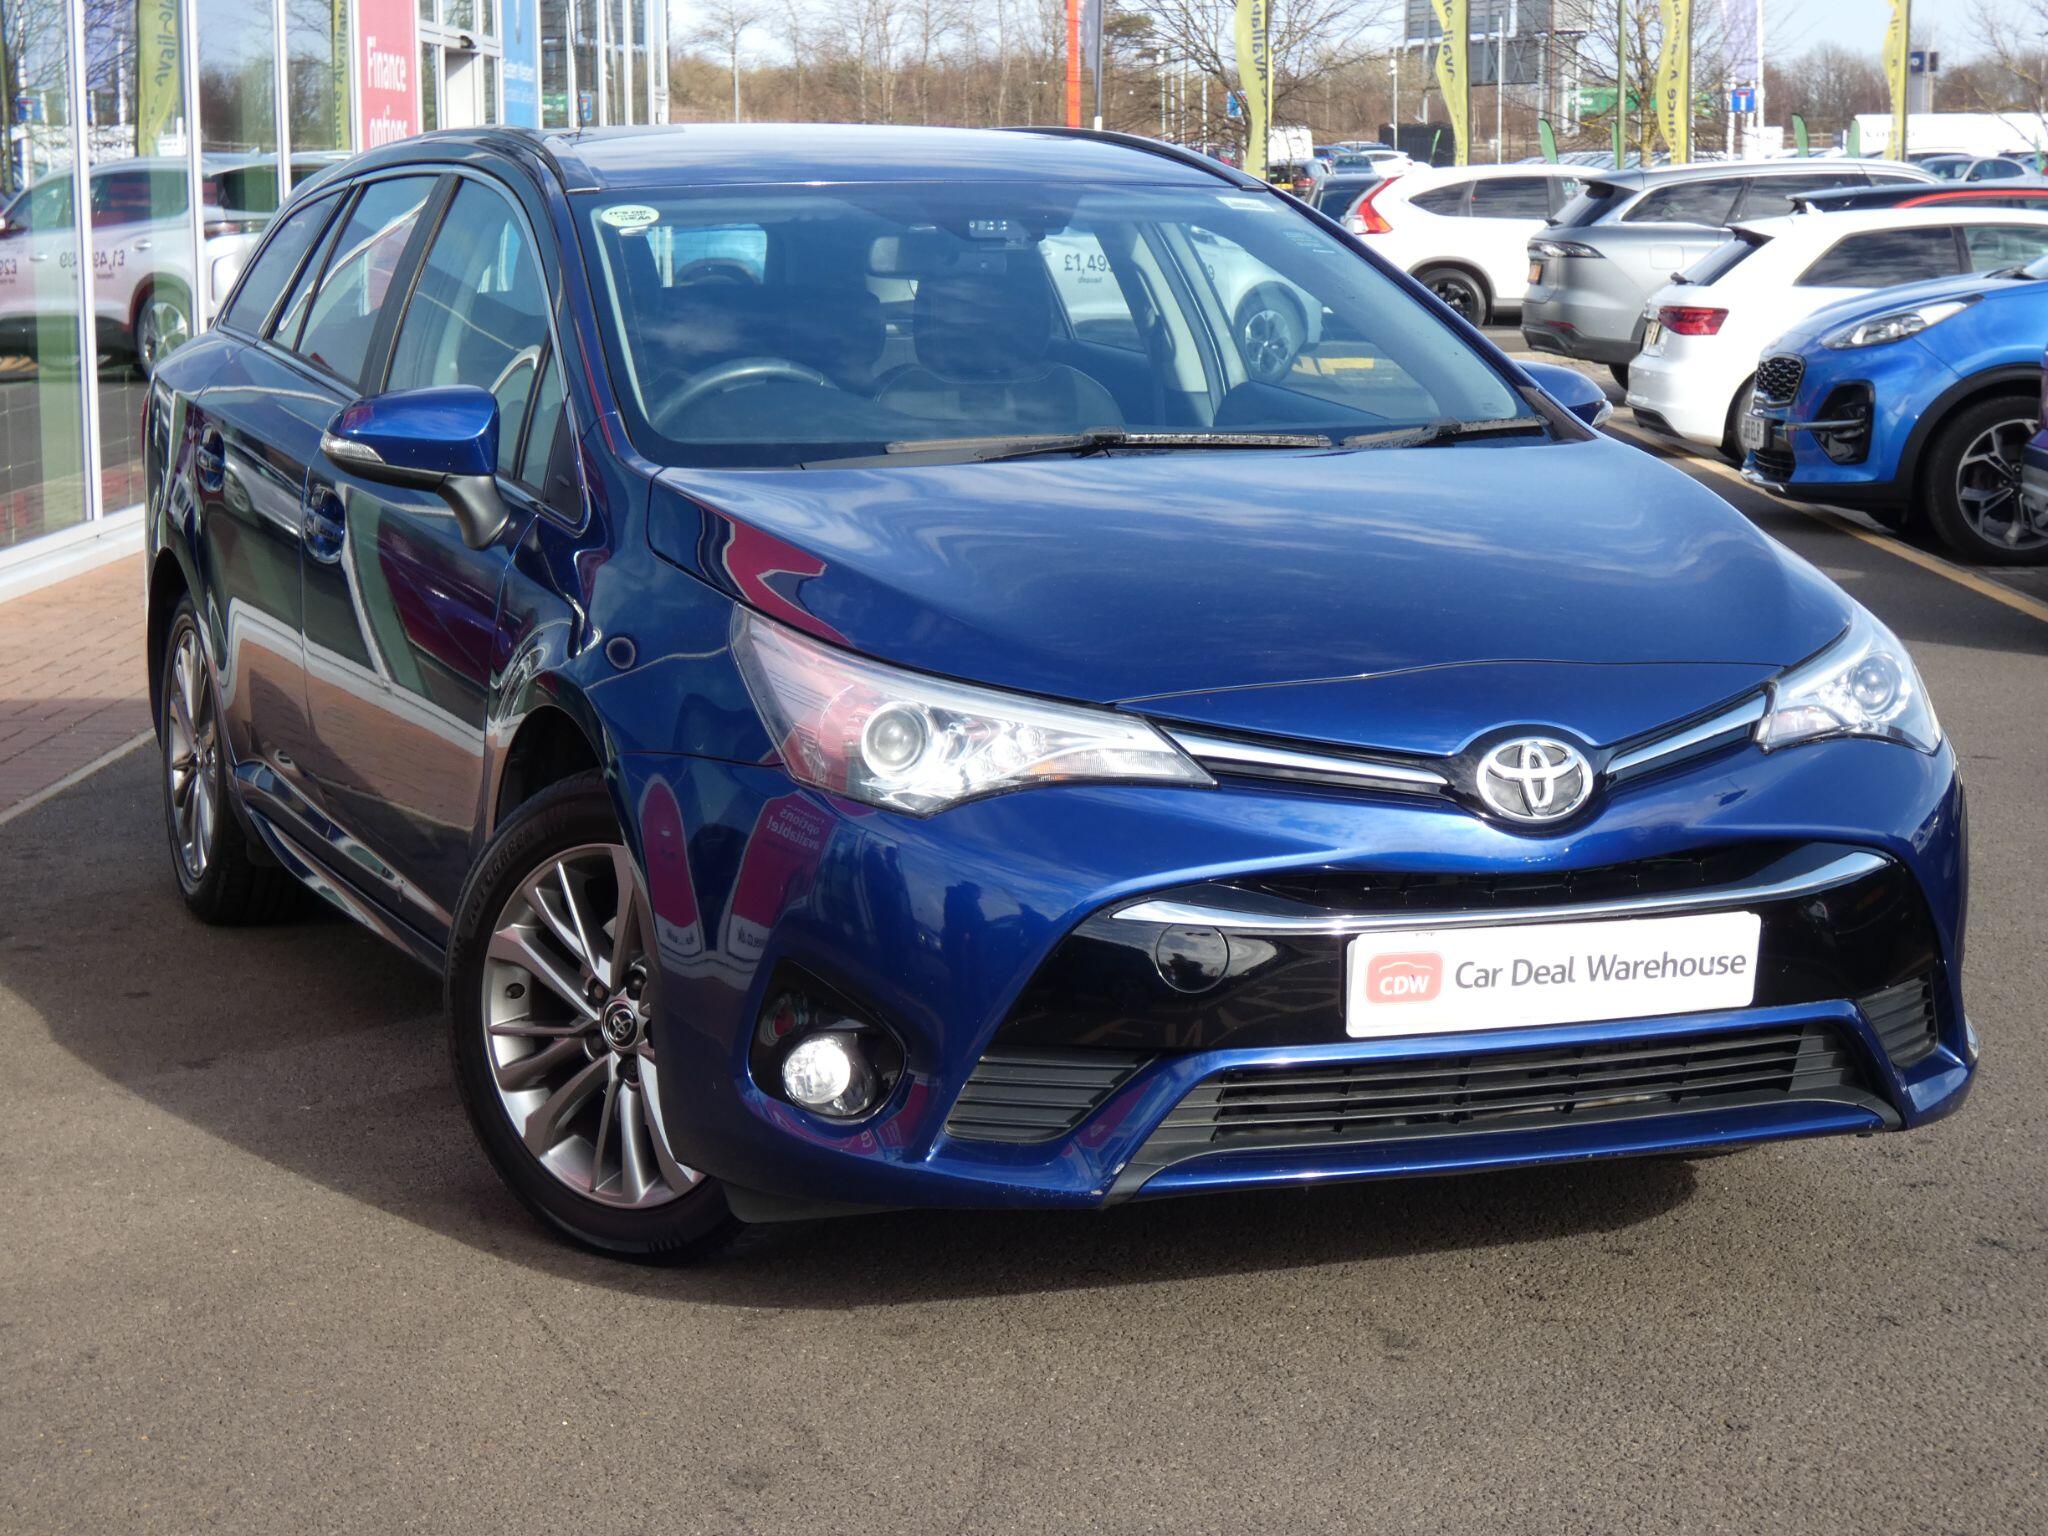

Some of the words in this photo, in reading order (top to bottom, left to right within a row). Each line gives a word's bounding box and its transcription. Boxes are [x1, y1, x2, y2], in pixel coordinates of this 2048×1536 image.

[366, 35, 406, 92] Finance
[1064, 252, 1111, 274] £1,49
[1379, 974, 1430, 996] CDW
[1455, 961, 1503, 989] Car
[1511, 956, 1576, 987] Deal
[1587, 951, 1747, 982] Warehouse
